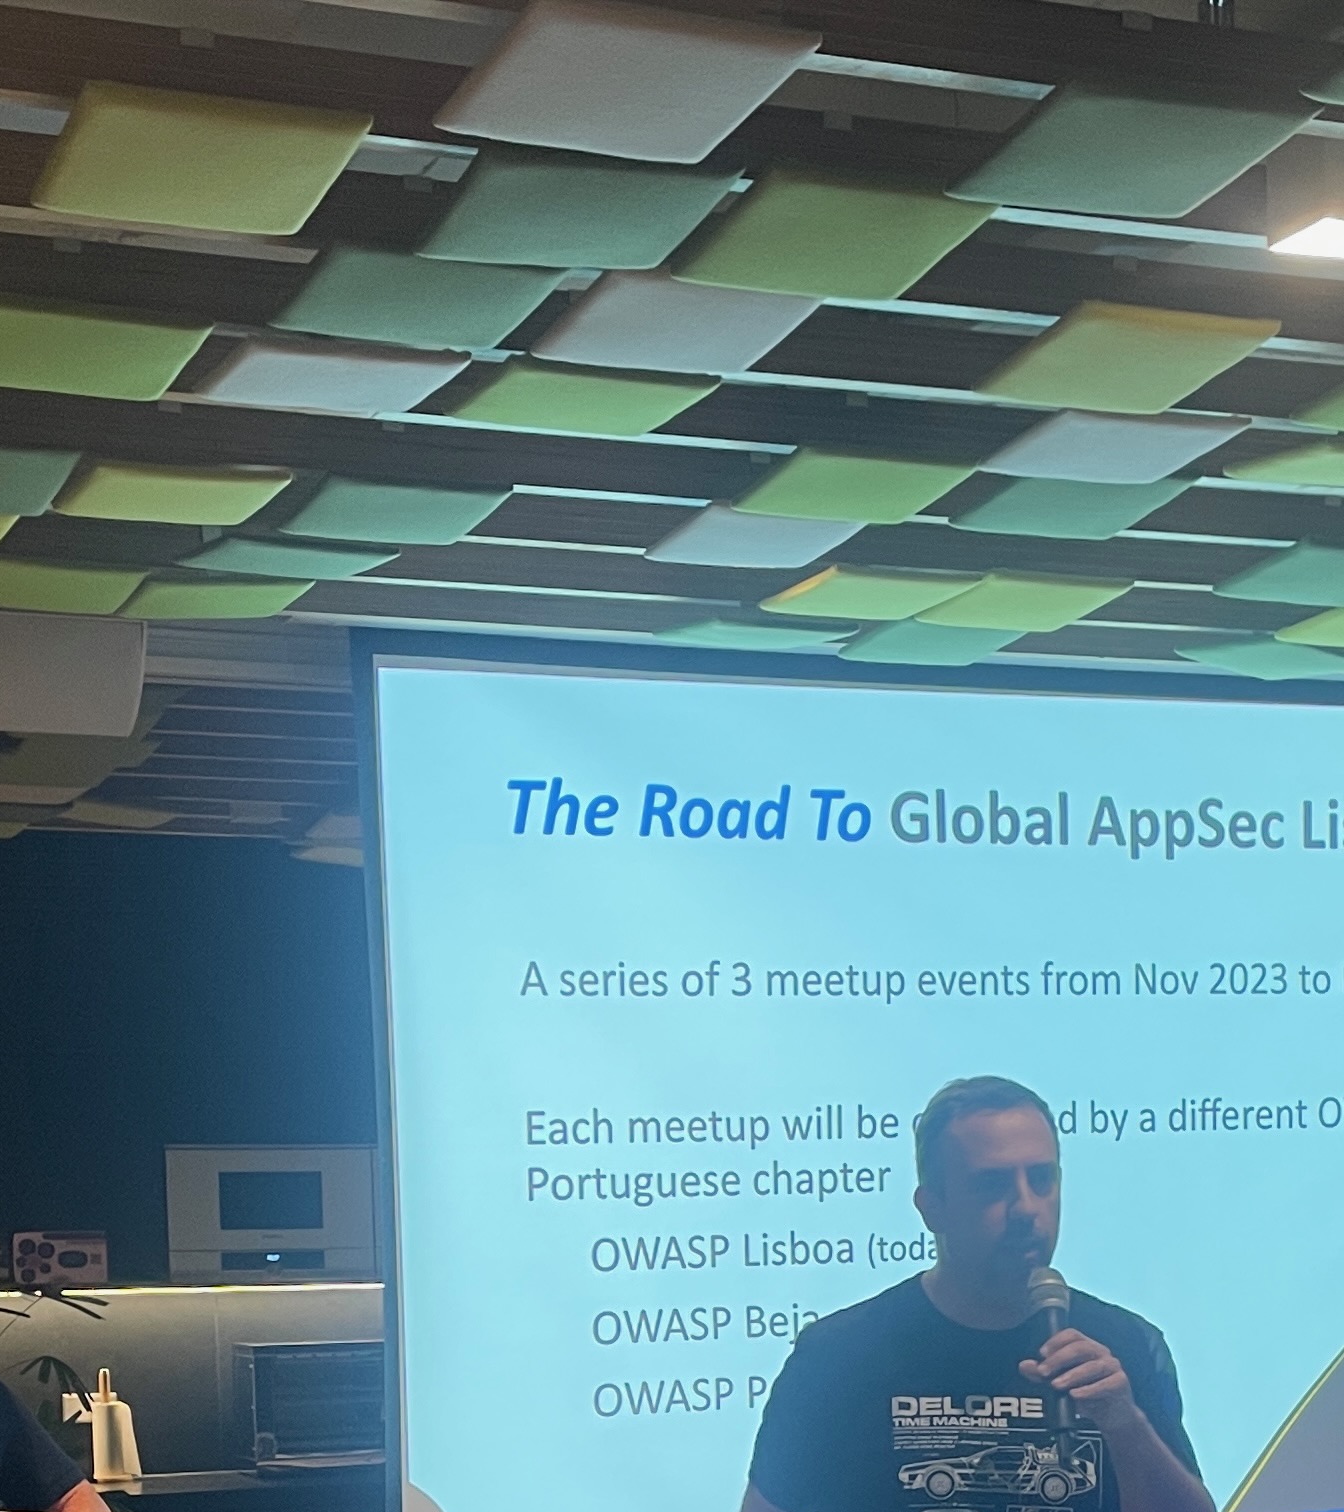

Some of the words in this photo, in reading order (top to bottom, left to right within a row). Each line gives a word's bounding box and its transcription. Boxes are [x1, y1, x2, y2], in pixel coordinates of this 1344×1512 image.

[506, 776, 619, 837] The
[638, 783, 791, 841] Road
[809, 788, 872, 843] To
[890, 788, 1069, 846] Global
[1087, 795, 1285, 860] AppSec
[519, 961, 548, 997] A
[559, 960, 669, 998] series
[681, 960, 721, 997] of
[731, 961, 752, 997] 3
[766, 965, 906, 1005] meetup
[917, 965, 1030, 997] events
[1040, 960, 1122, 996] from
[1134, 962, 1199, 996] Nov
[1209, 961, 1289, 996] 2023
[1298, 964, 1331, 995] to
[525, 1107, 614, 1146] Each
[628, 1110, 770, 1150] meetup
[781, 1104, 844, 1142] will
[856, 1103, 900, 1140] be
[1090, 1099, 1129, 1142] by
[1139, 1108, 1157, 1134] a
[1168, 1097, 1309, 1132] different
[526, 1165, 741, 1208] Portuguese
[752, 1160, 892, 1203] chapter
[591, 1234, 730, 1273] OWASP
[743, 1230, 854, 1268] Lisboa
[592, 1306, 732, 1345] OWASP
[593, 1377, 734, 1418] OWASP
[891, 1395, 1044, 1419] DELORE
[892, 1417, 931, 1427] TIME
[932, 1416, 1009, 1428] MACHINE
